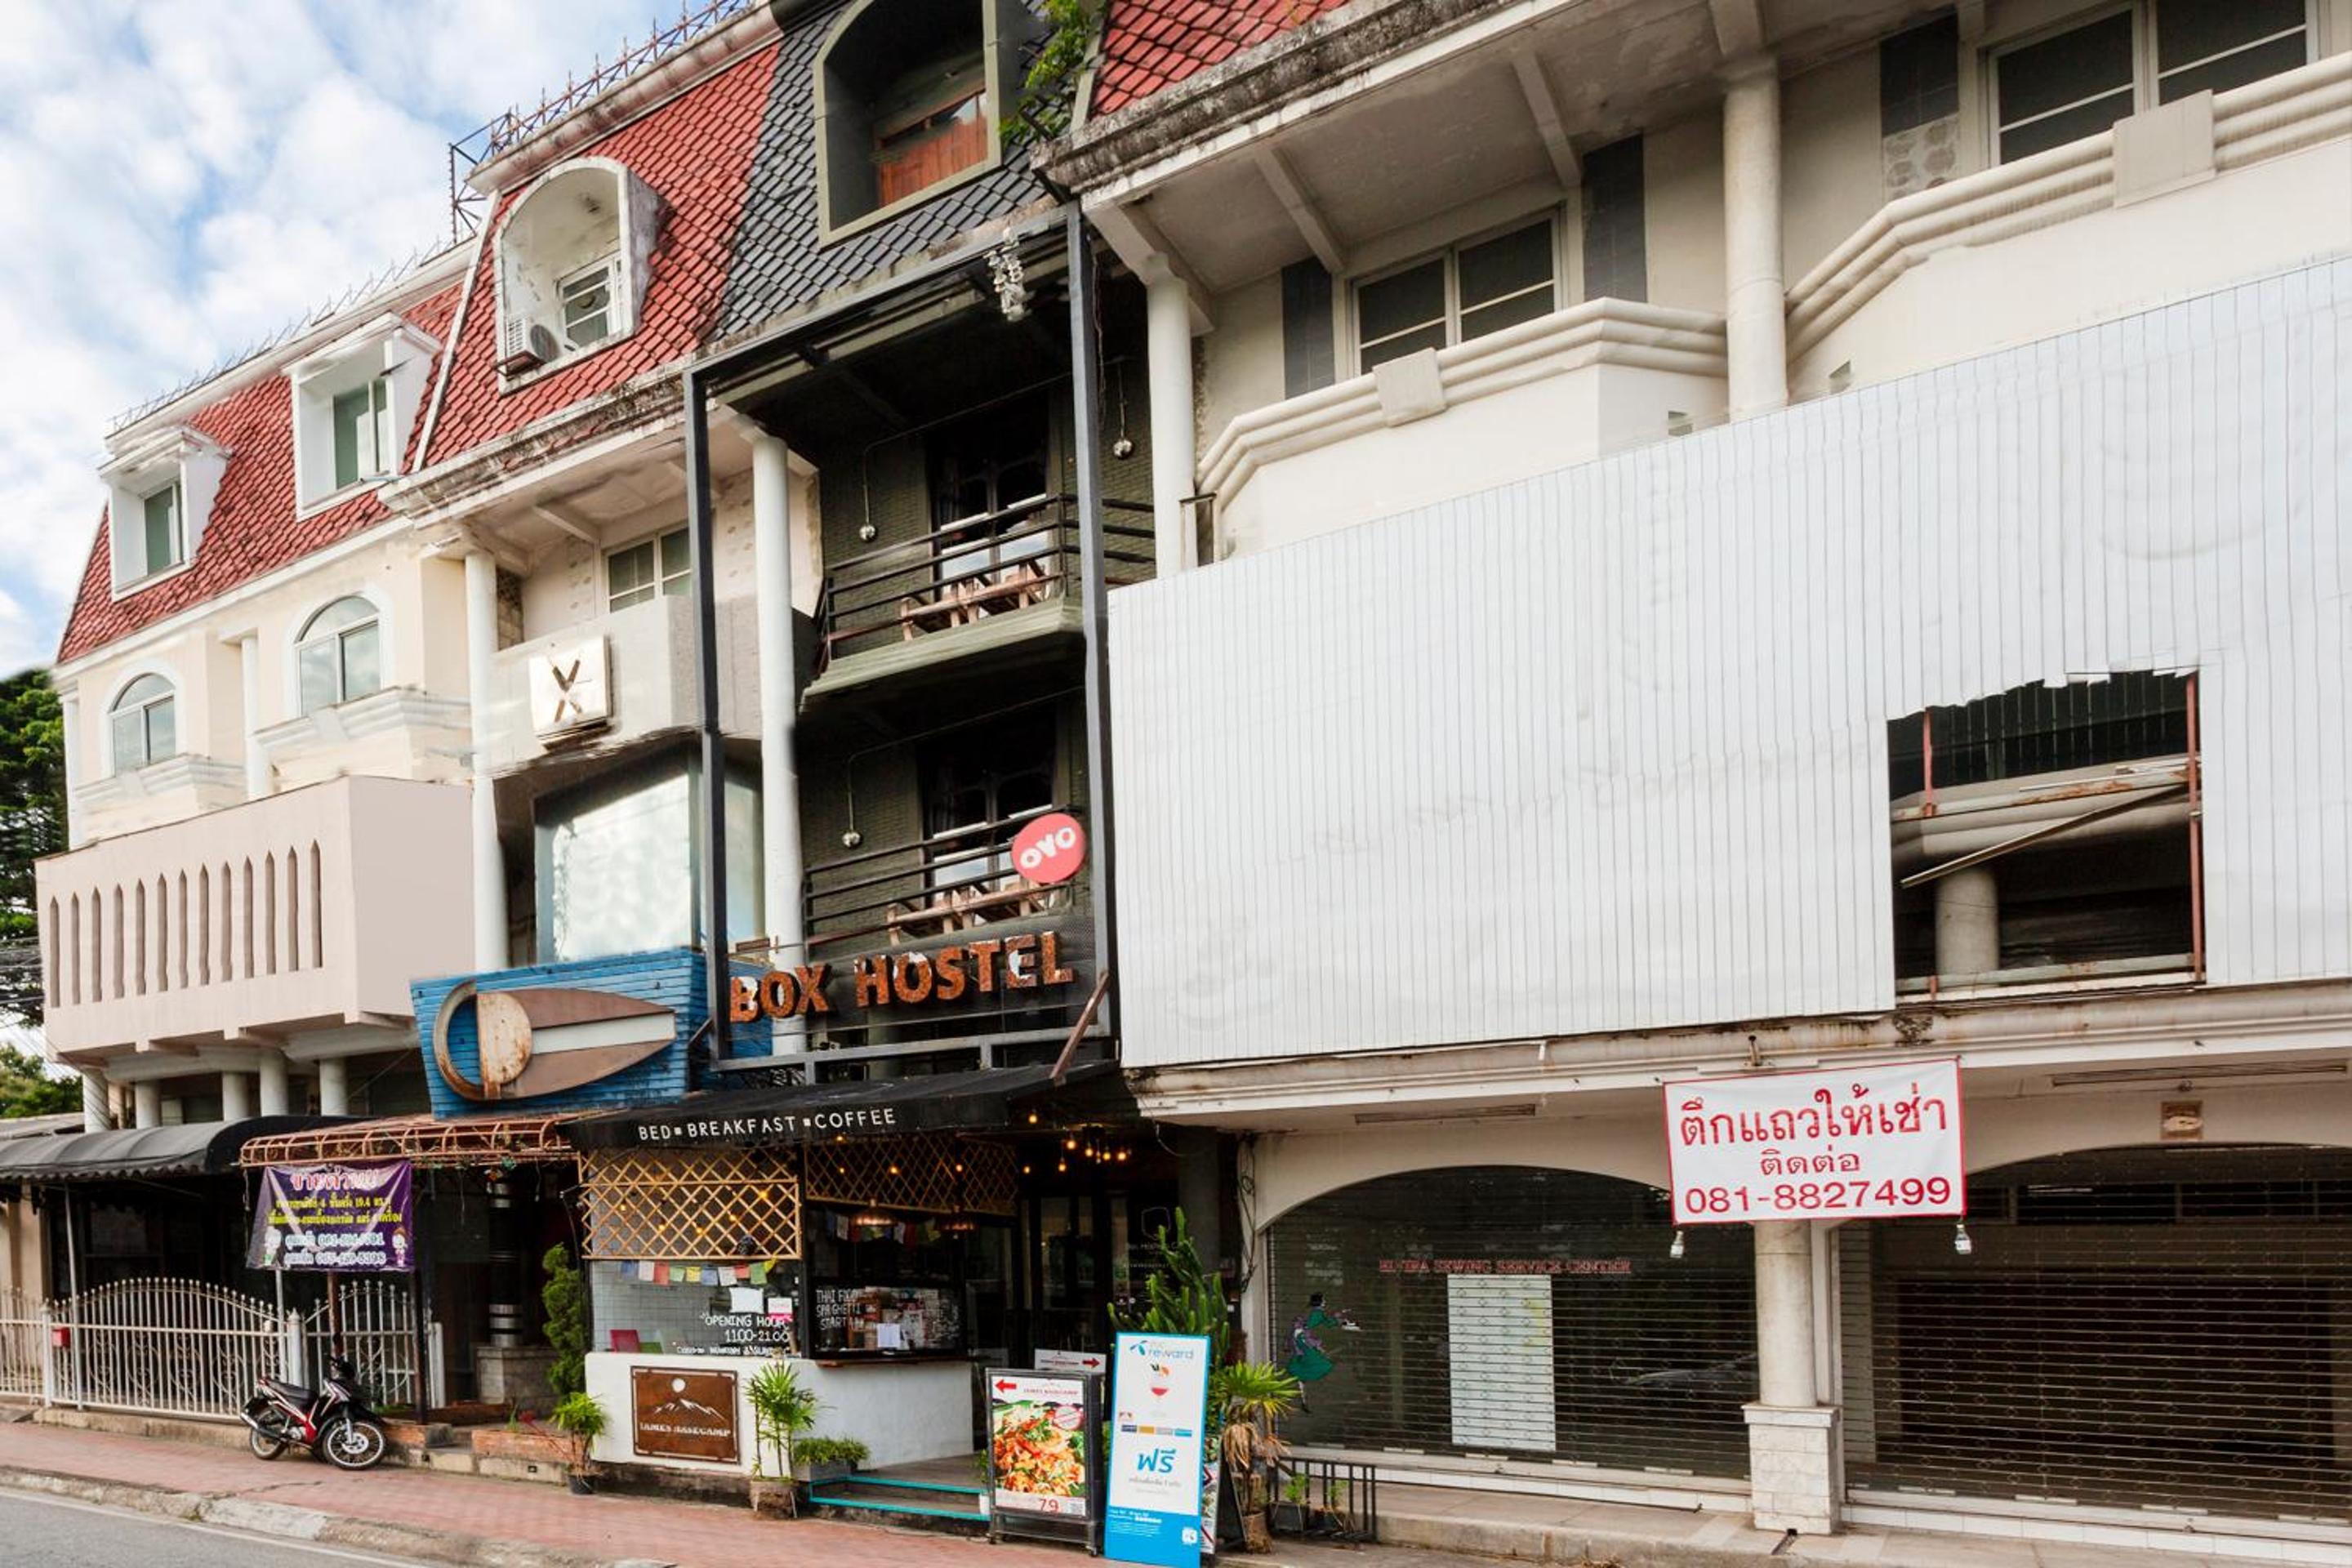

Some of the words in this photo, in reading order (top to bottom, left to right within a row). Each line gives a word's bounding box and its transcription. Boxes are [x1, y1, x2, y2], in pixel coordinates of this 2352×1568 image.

[730, 963, 830, 1022] BOX
[853, 930, 1073, 1008] HOSTEL
[638, 1125, 670, 1140] BED
[688, 1116, 796, 1138] BREAKFAST
[814, 1107, 896, 1129] COFFEE
[1680, 1082, 1947, 1146] ตึกแถวให้เช่า
[1760, 1144, 1860, 1176] ติดต่อ
[1685, 1177, 1951, 1214] 081-8827499
[705, 1314, 753, 1327] OPENING
[1136, 1448, 1178, 1473] ฟรี
[1039, 1498, 1059, 1513] 79
